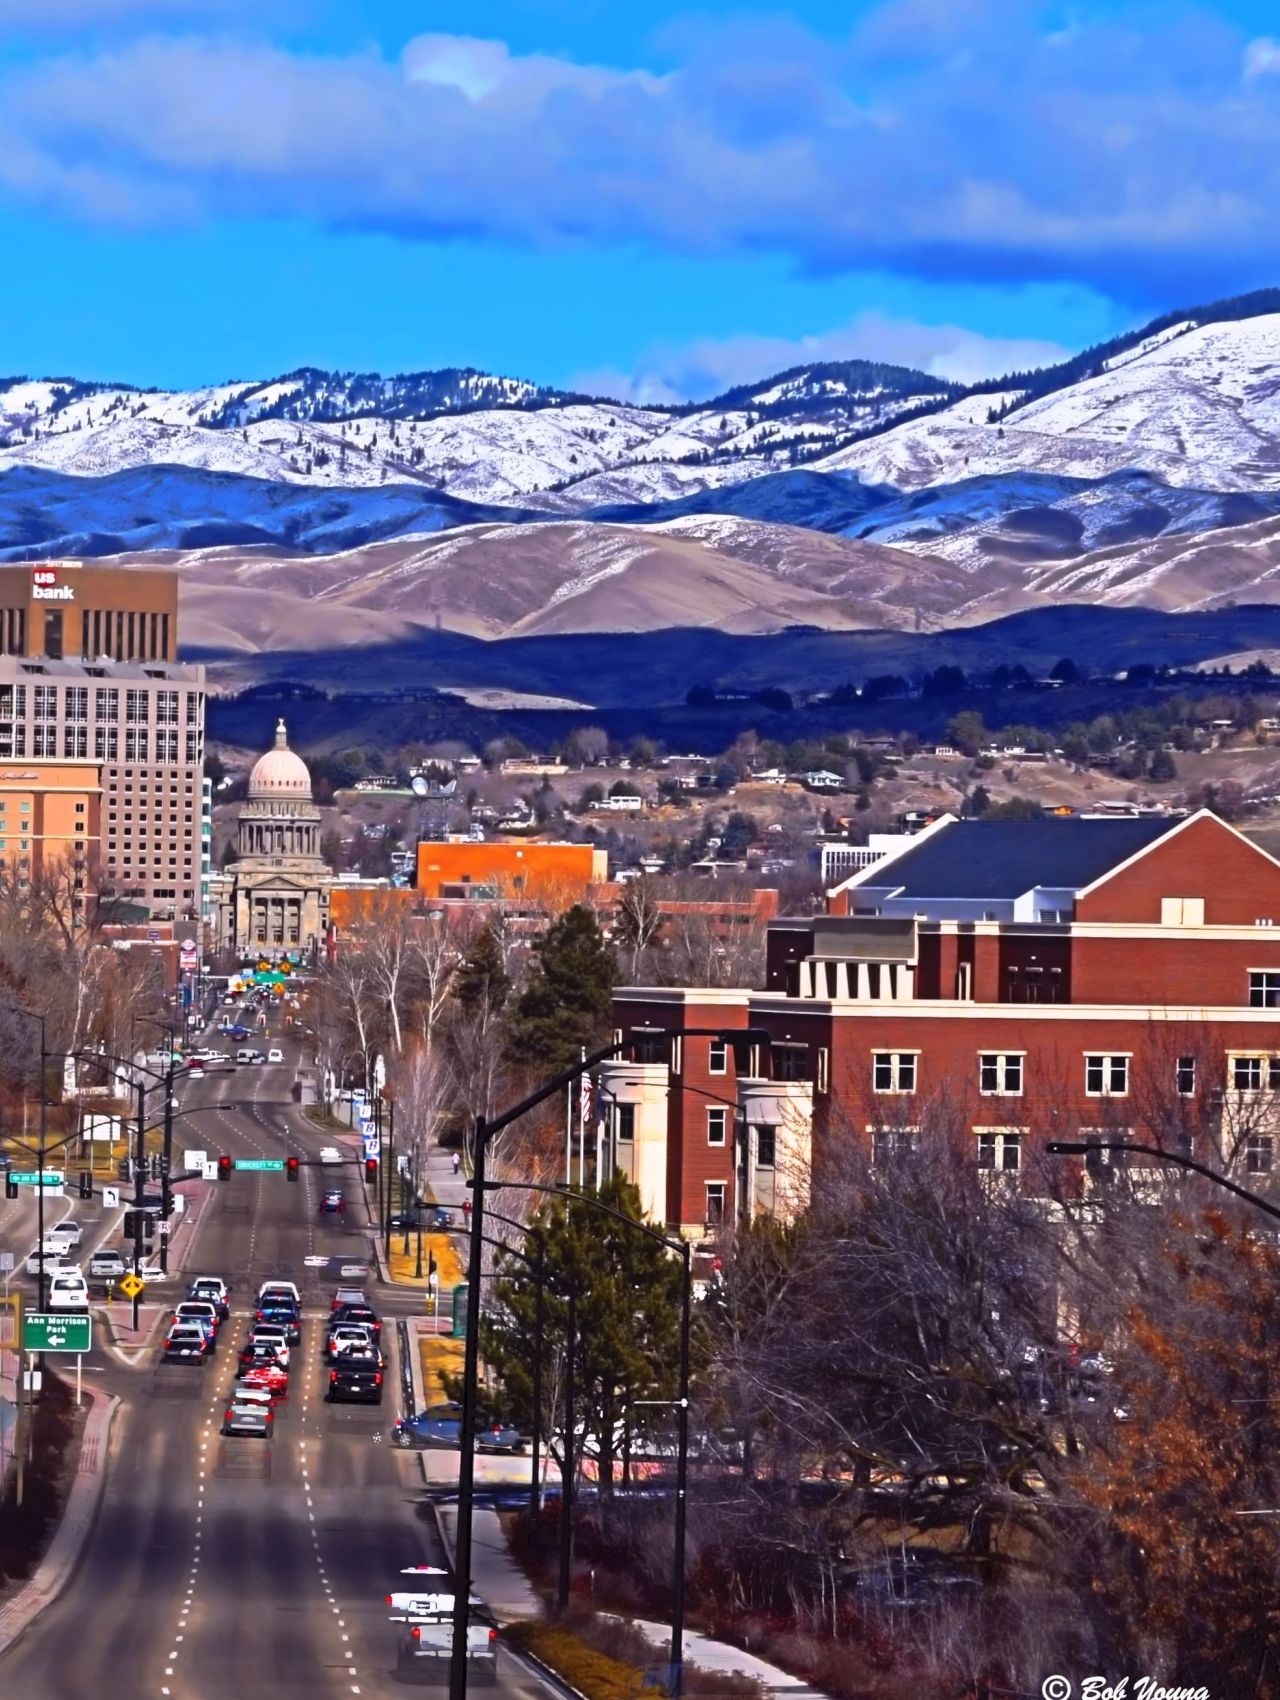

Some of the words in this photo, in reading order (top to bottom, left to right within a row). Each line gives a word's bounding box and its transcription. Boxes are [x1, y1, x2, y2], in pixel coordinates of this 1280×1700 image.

[32, 585, 75, 599] bank
[369, 1141, 378, 1151] B
[27, 1317, 45, 1325] Ann
[48, 1317, 87, 1325] Morrison
[46, 1326, 67, 1334] Park
